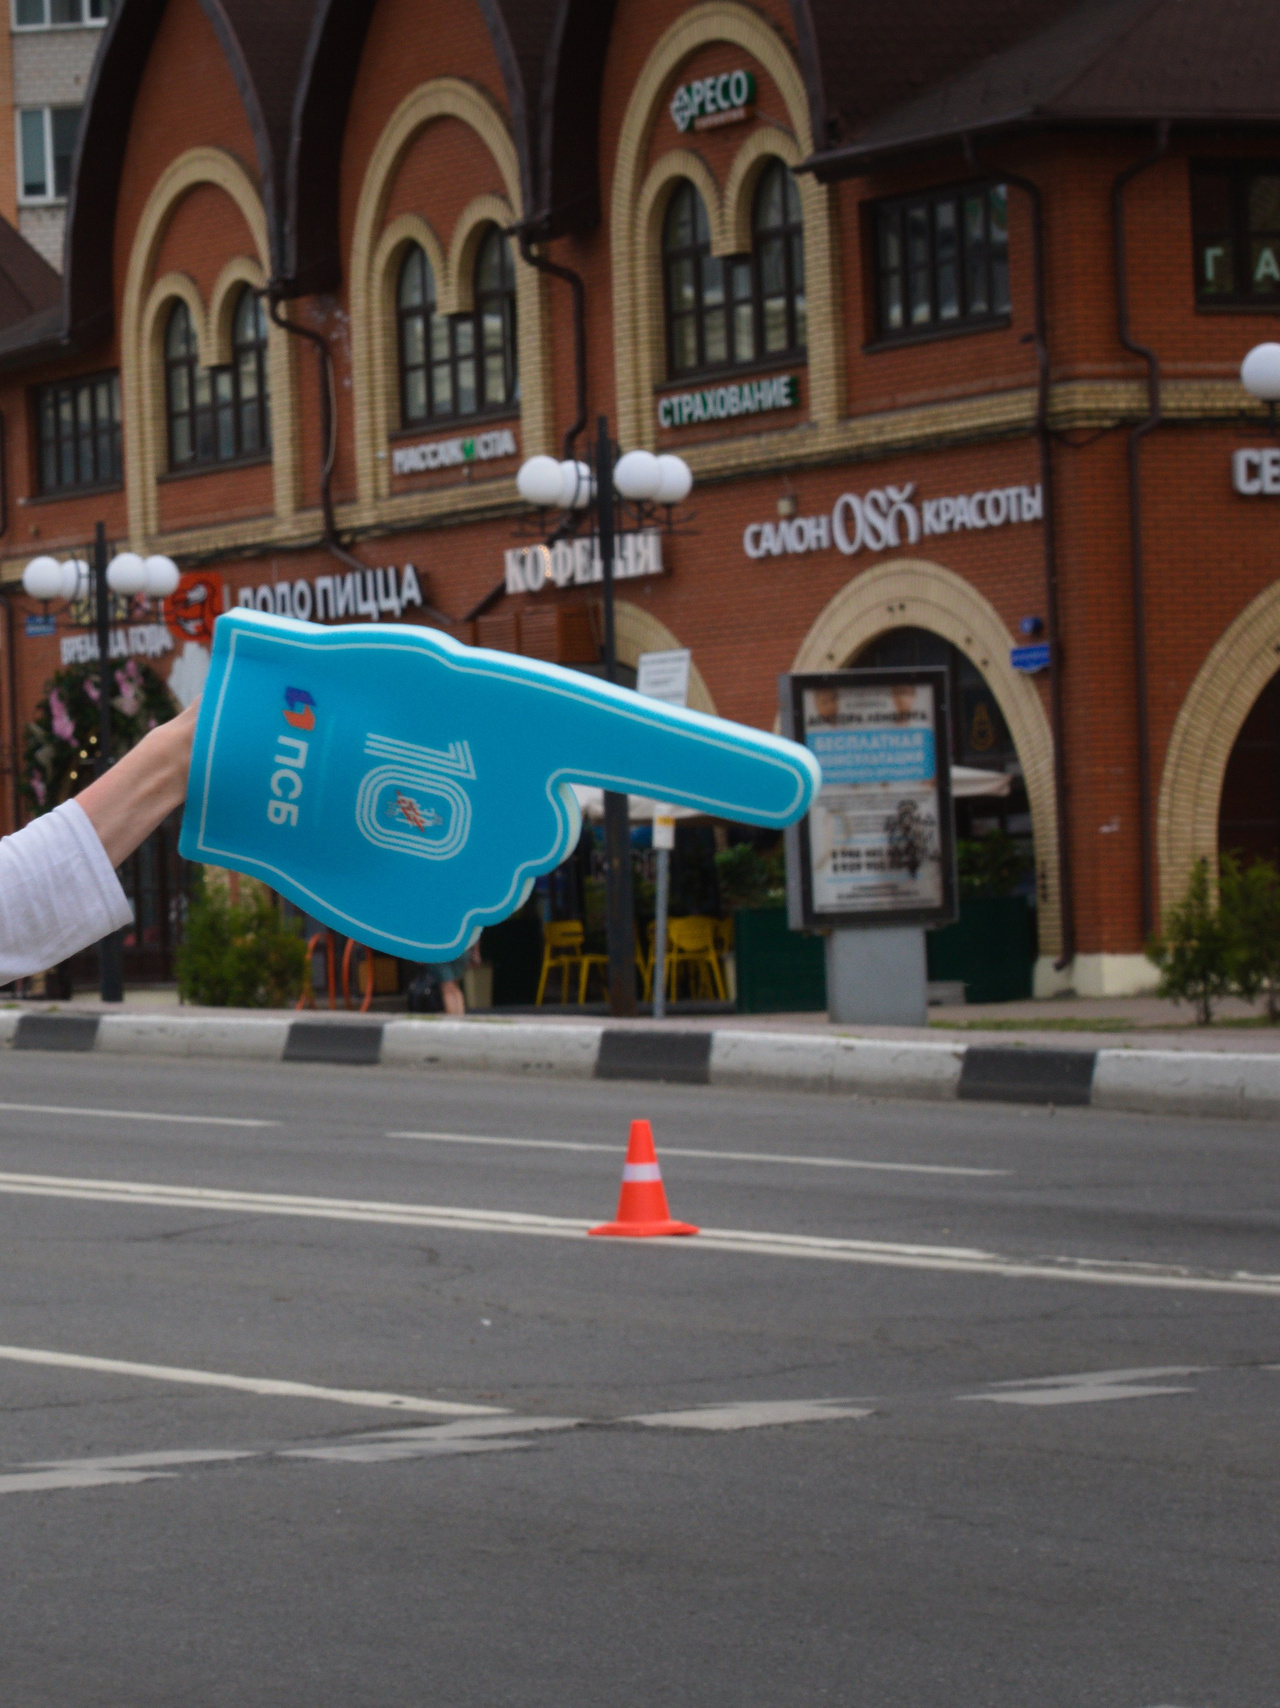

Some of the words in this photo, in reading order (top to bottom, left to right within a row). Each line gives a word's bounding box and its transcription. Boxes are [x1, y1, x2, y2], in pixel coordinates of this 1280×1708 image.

[691, 70, 748, 117] РЕСО
[658, 375, 792, 428] СТРАХОВАНИЕ
[743, 515, 831, 558] САЛОН
[922, 484, 1043, 534] КРАСОТЫ
[315, 563, 420, 621] ПИЦЦА
[267, 735, 309, 827] ПСБ
